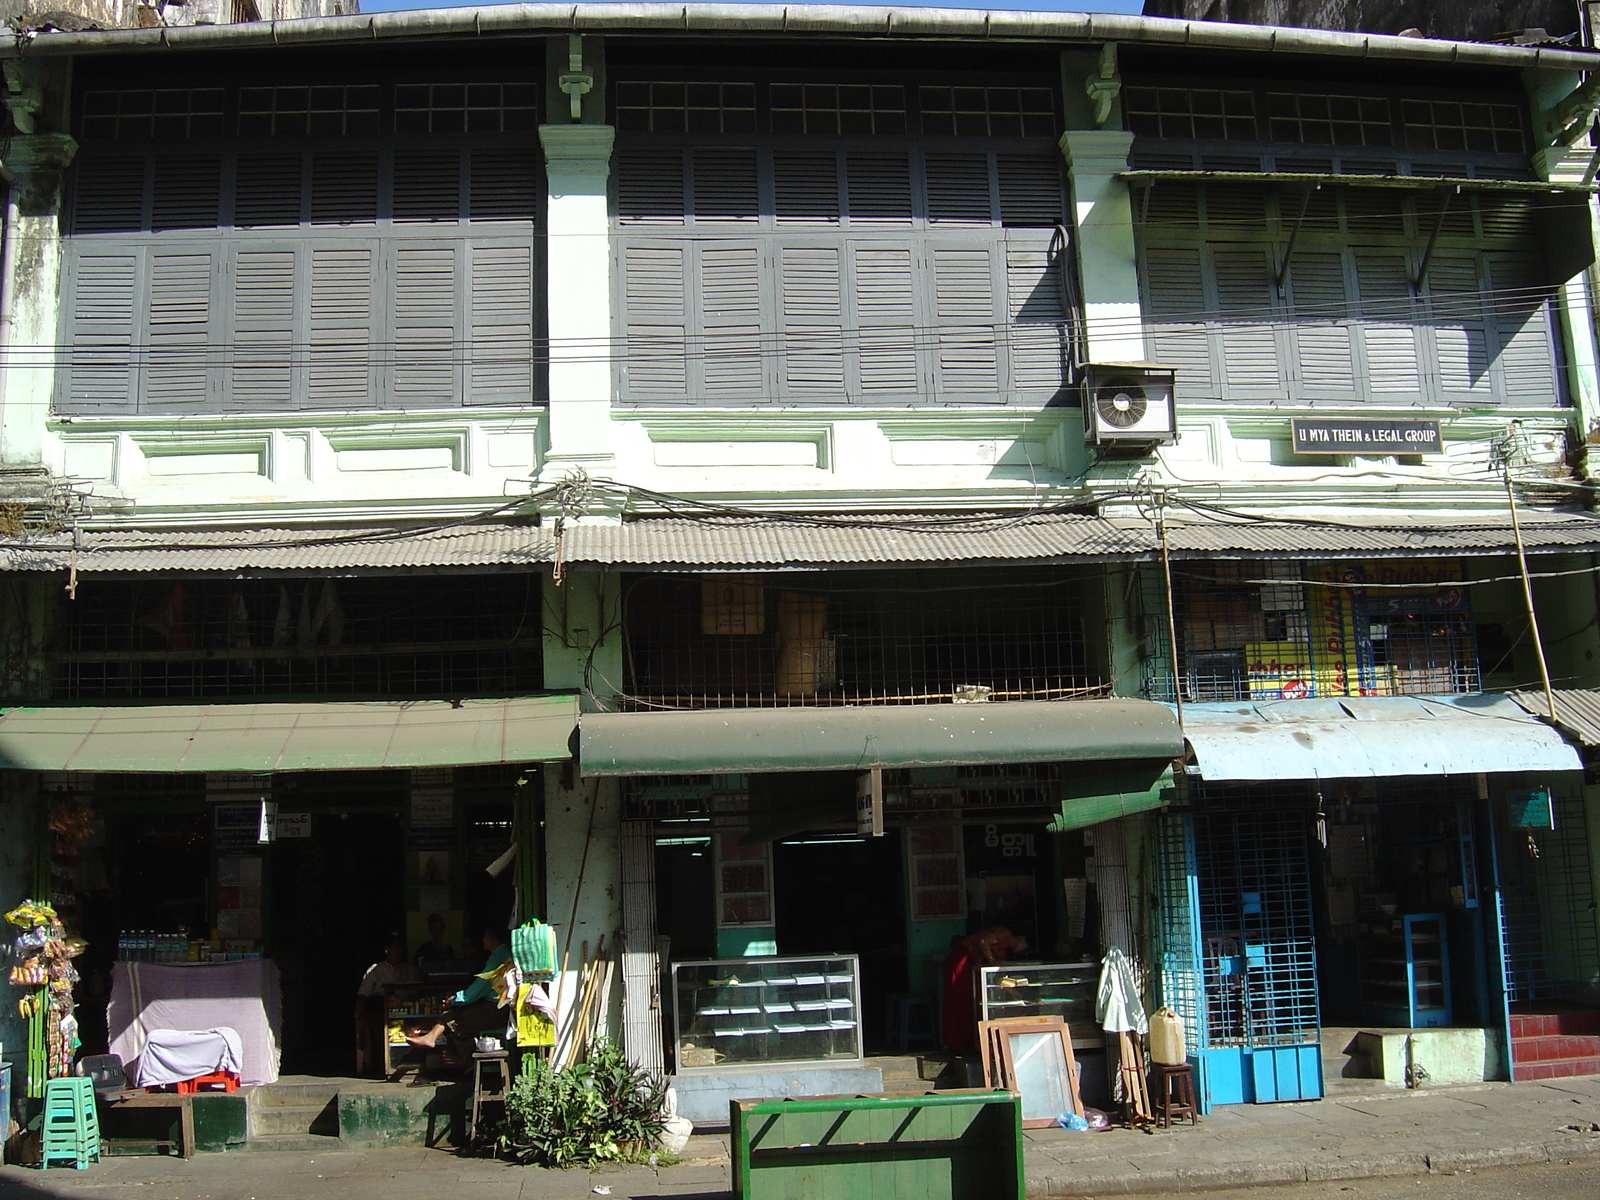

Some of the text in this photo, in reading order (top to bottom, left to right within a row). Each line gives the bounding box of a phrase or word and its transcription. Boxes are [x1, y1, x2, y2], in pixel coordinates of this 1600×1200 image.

[1299, 429, 1436, 443] U MYA THEIN & LEGAL GROUP
